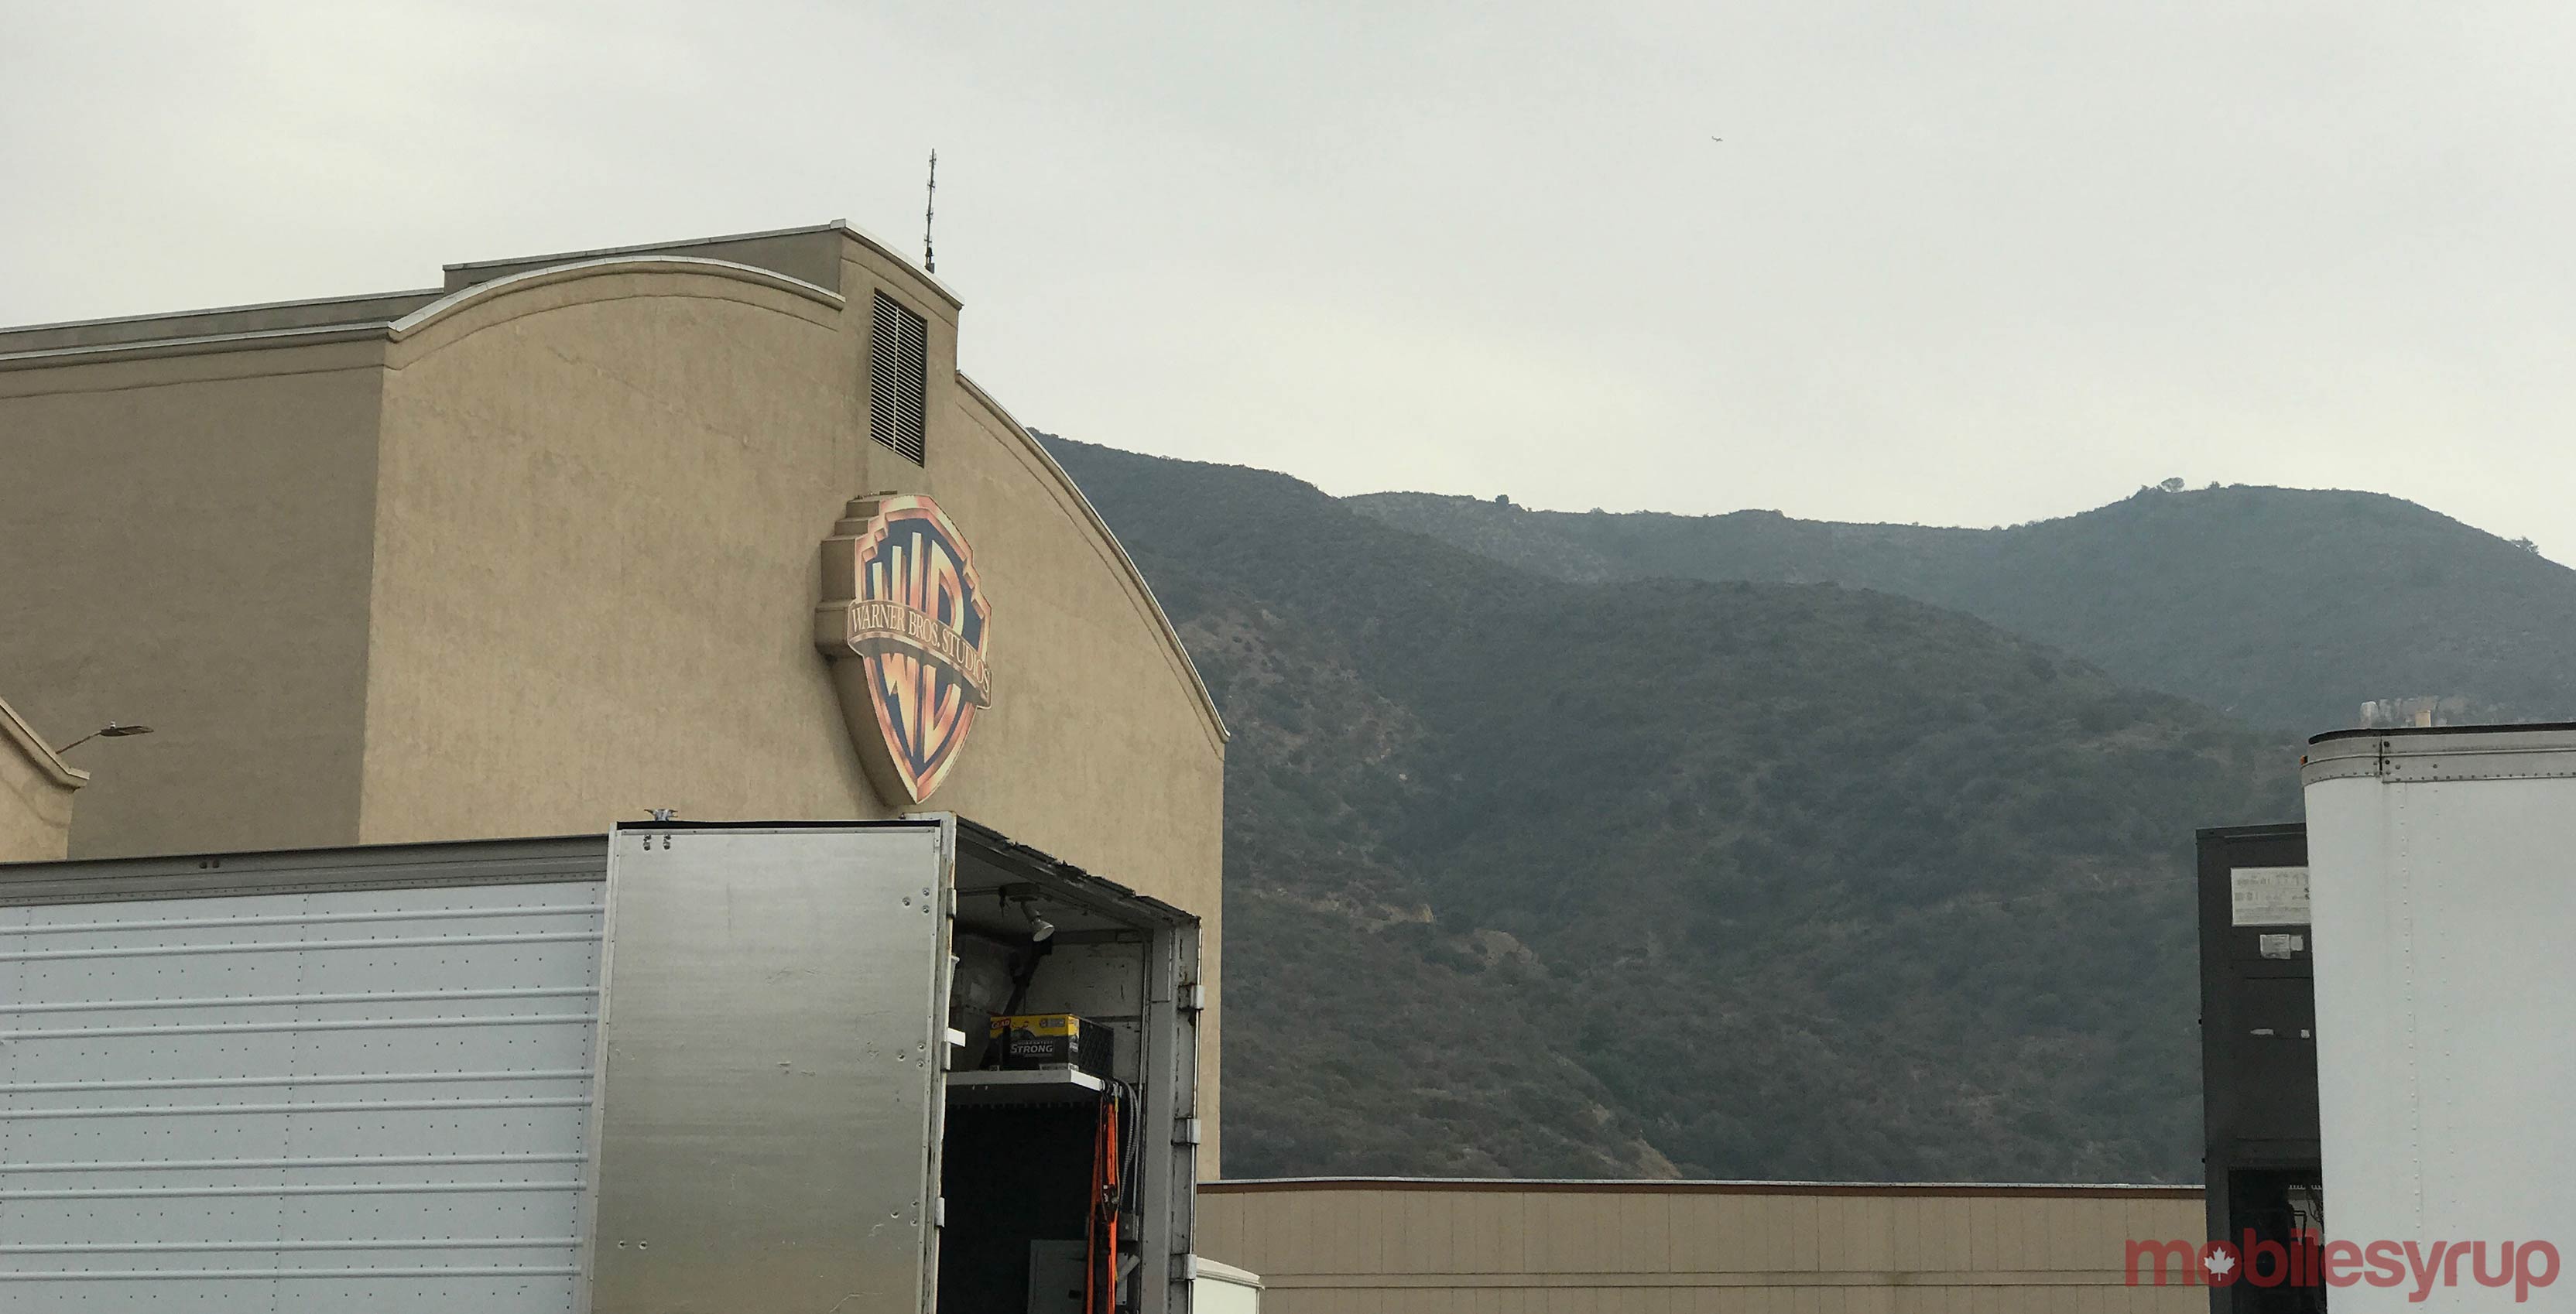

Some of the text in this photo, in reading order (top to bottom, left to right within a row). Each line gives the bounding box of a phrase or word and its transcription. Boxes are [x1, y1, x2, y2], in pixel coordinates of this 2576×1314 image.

[851, 604, 989, 693] WARNER BROS. STUDIOS
[1009, 1043, 1053, 1053] STRONG
